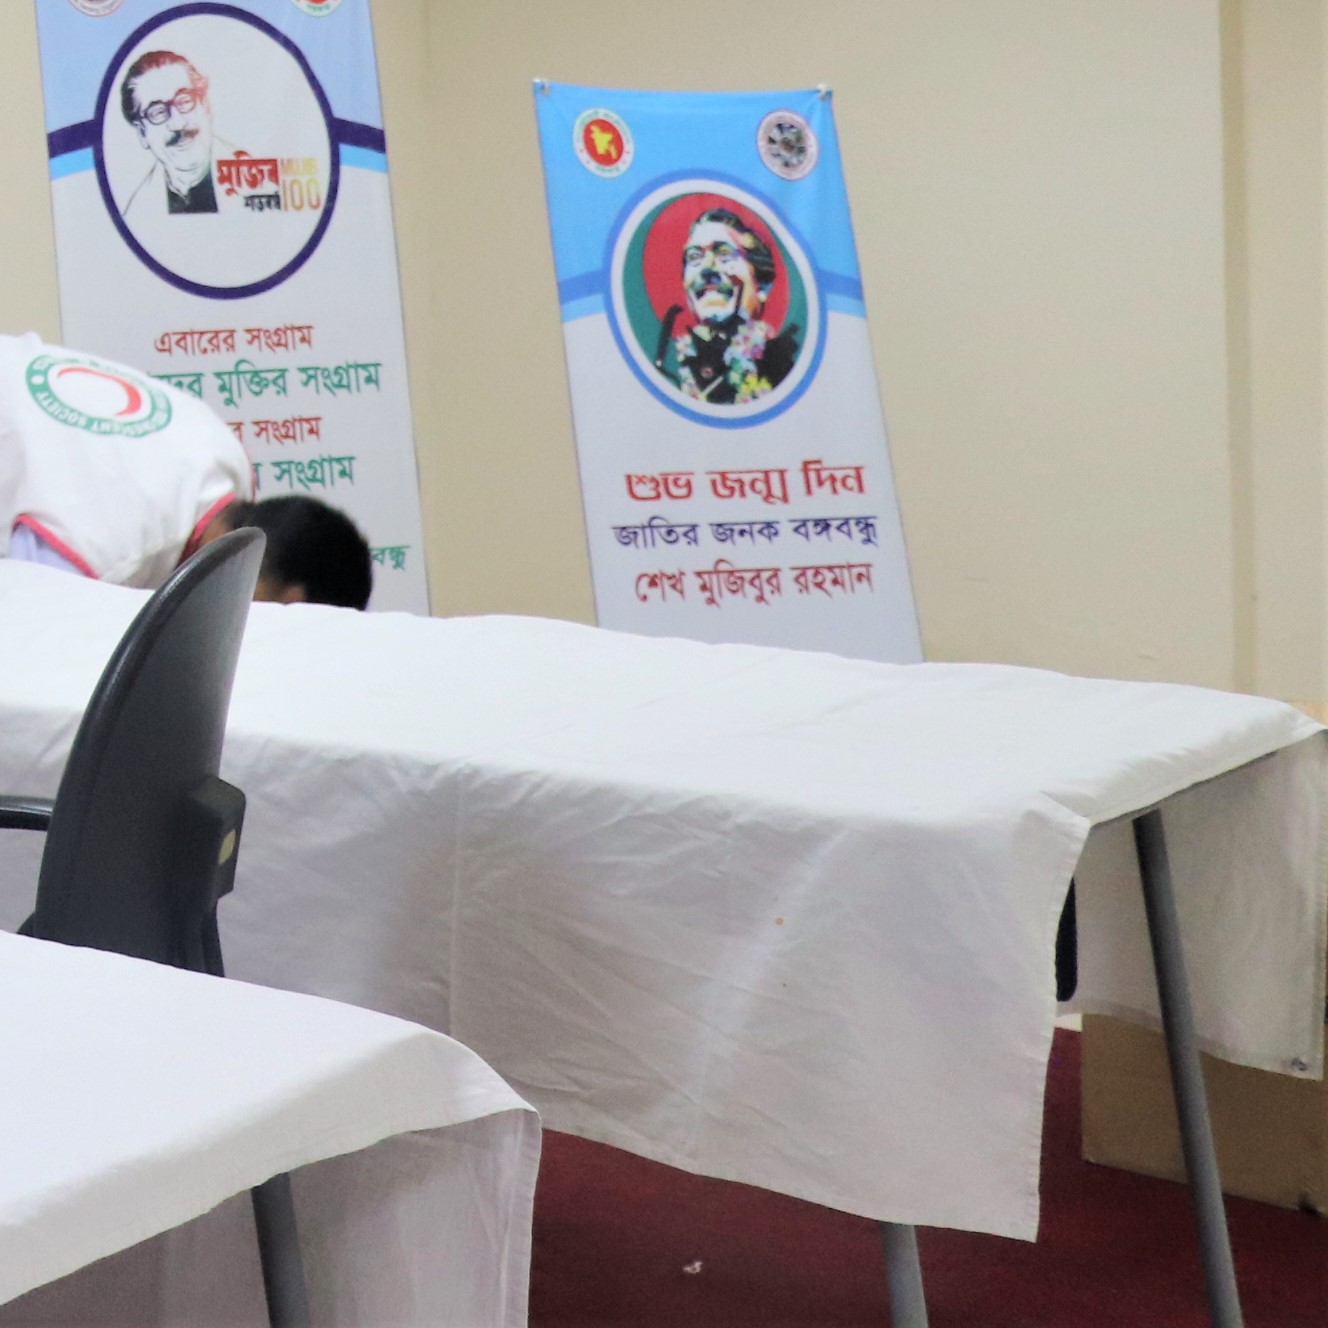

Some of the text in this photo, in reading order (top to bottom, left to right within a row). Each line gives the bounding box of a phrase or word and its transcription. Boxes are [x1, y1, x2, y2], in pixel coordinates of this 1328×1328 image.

[154, 325, 314, 356] এবারের সংগ্রাম
[214, 359, 288, 408] মুক্তির
[297, 360, 382, 396] সংগ্রাম
[251, 415, 322, 445] সংগ্রাম
[271, 453, 356, 490] সংগ্রাম
[625, 472, 695, 501] শুভ
[802, 459, 864, 495] দিন
[611, 515, 878, 550] জাতির জনক বঙ্গবন্ধু
[635, 558, 873, 608] শেখ মুজিবুর রহমান
